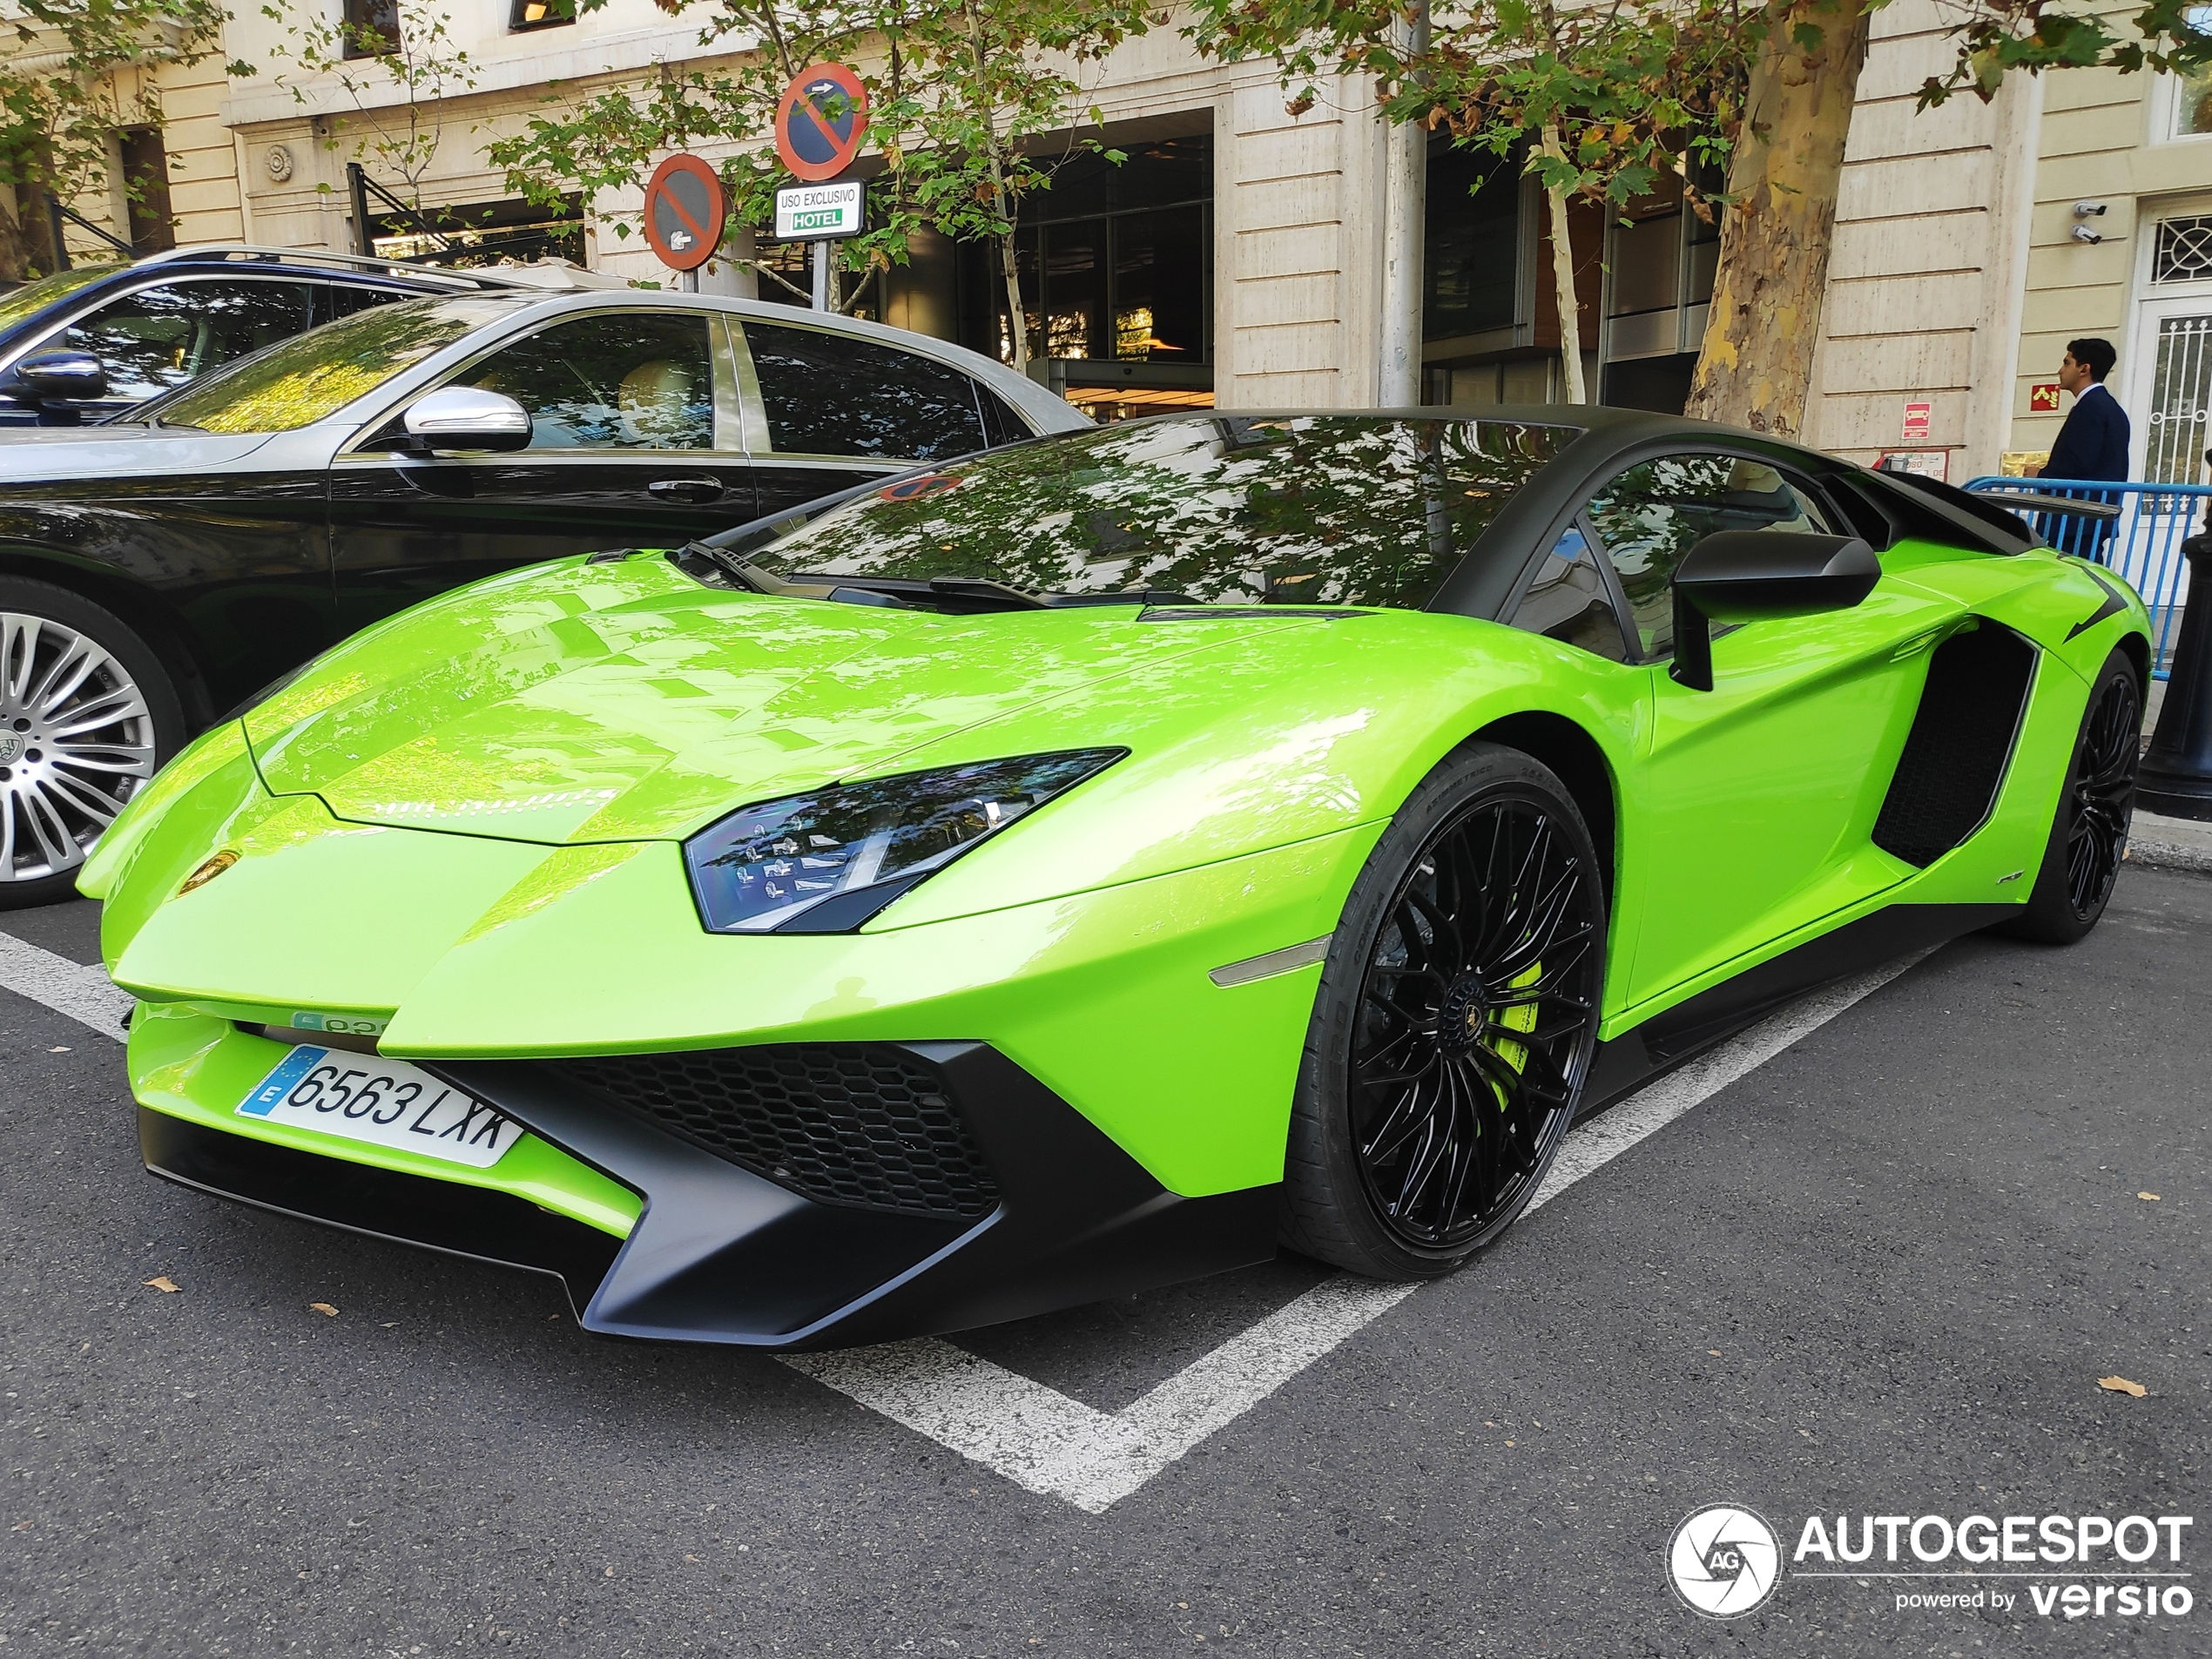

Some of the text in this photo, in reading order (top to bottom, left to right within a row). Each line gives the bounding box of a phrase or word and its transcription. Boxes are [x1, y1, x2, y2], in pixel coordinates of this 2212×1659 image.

[781, 188, 855, 208] USO EXCLUSIVO
[794, 211, 841, 228] HOTEL
[258, 1084, 283, 1103] E
[287, 1065, 508, 1150] 6563 LXK
